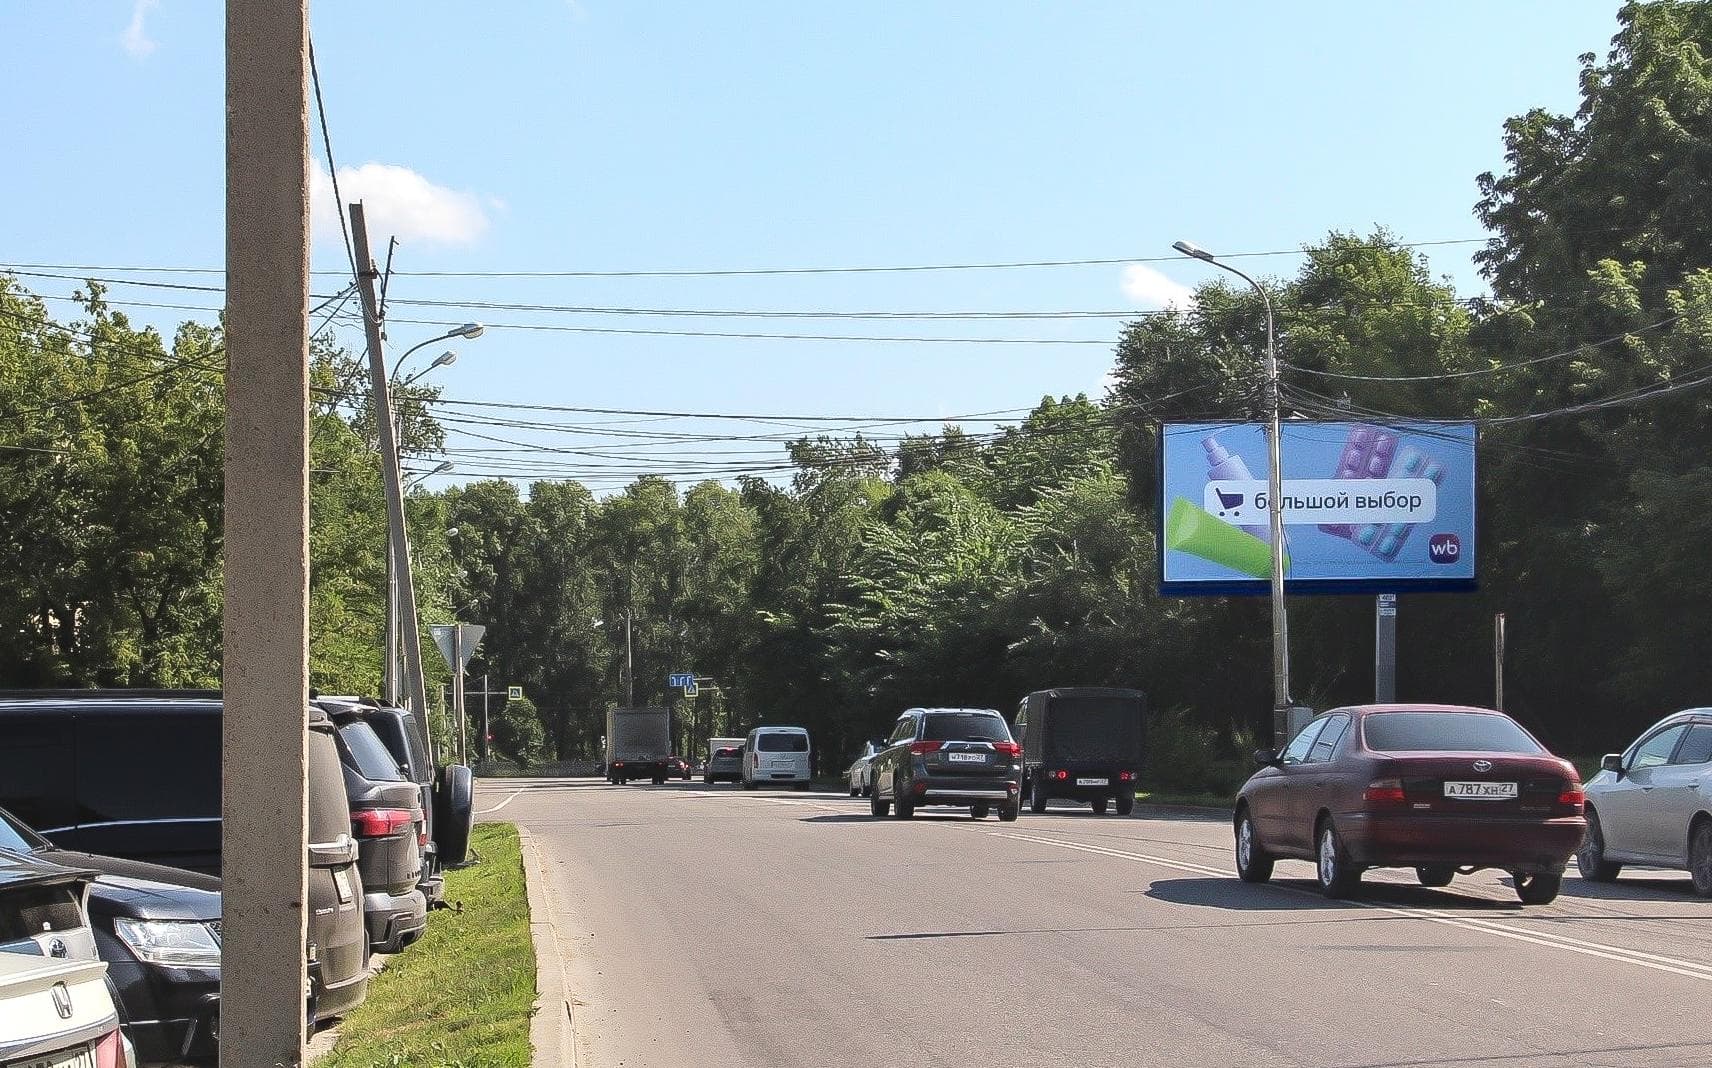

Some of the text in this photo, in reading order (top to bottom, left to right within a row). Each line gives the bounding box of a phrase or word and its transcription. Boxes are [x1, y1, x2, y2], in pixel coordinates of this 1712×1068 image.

[1254, 490, 1422, 512] бльшой выбор
[1431, 541, 1458, 556] wb
